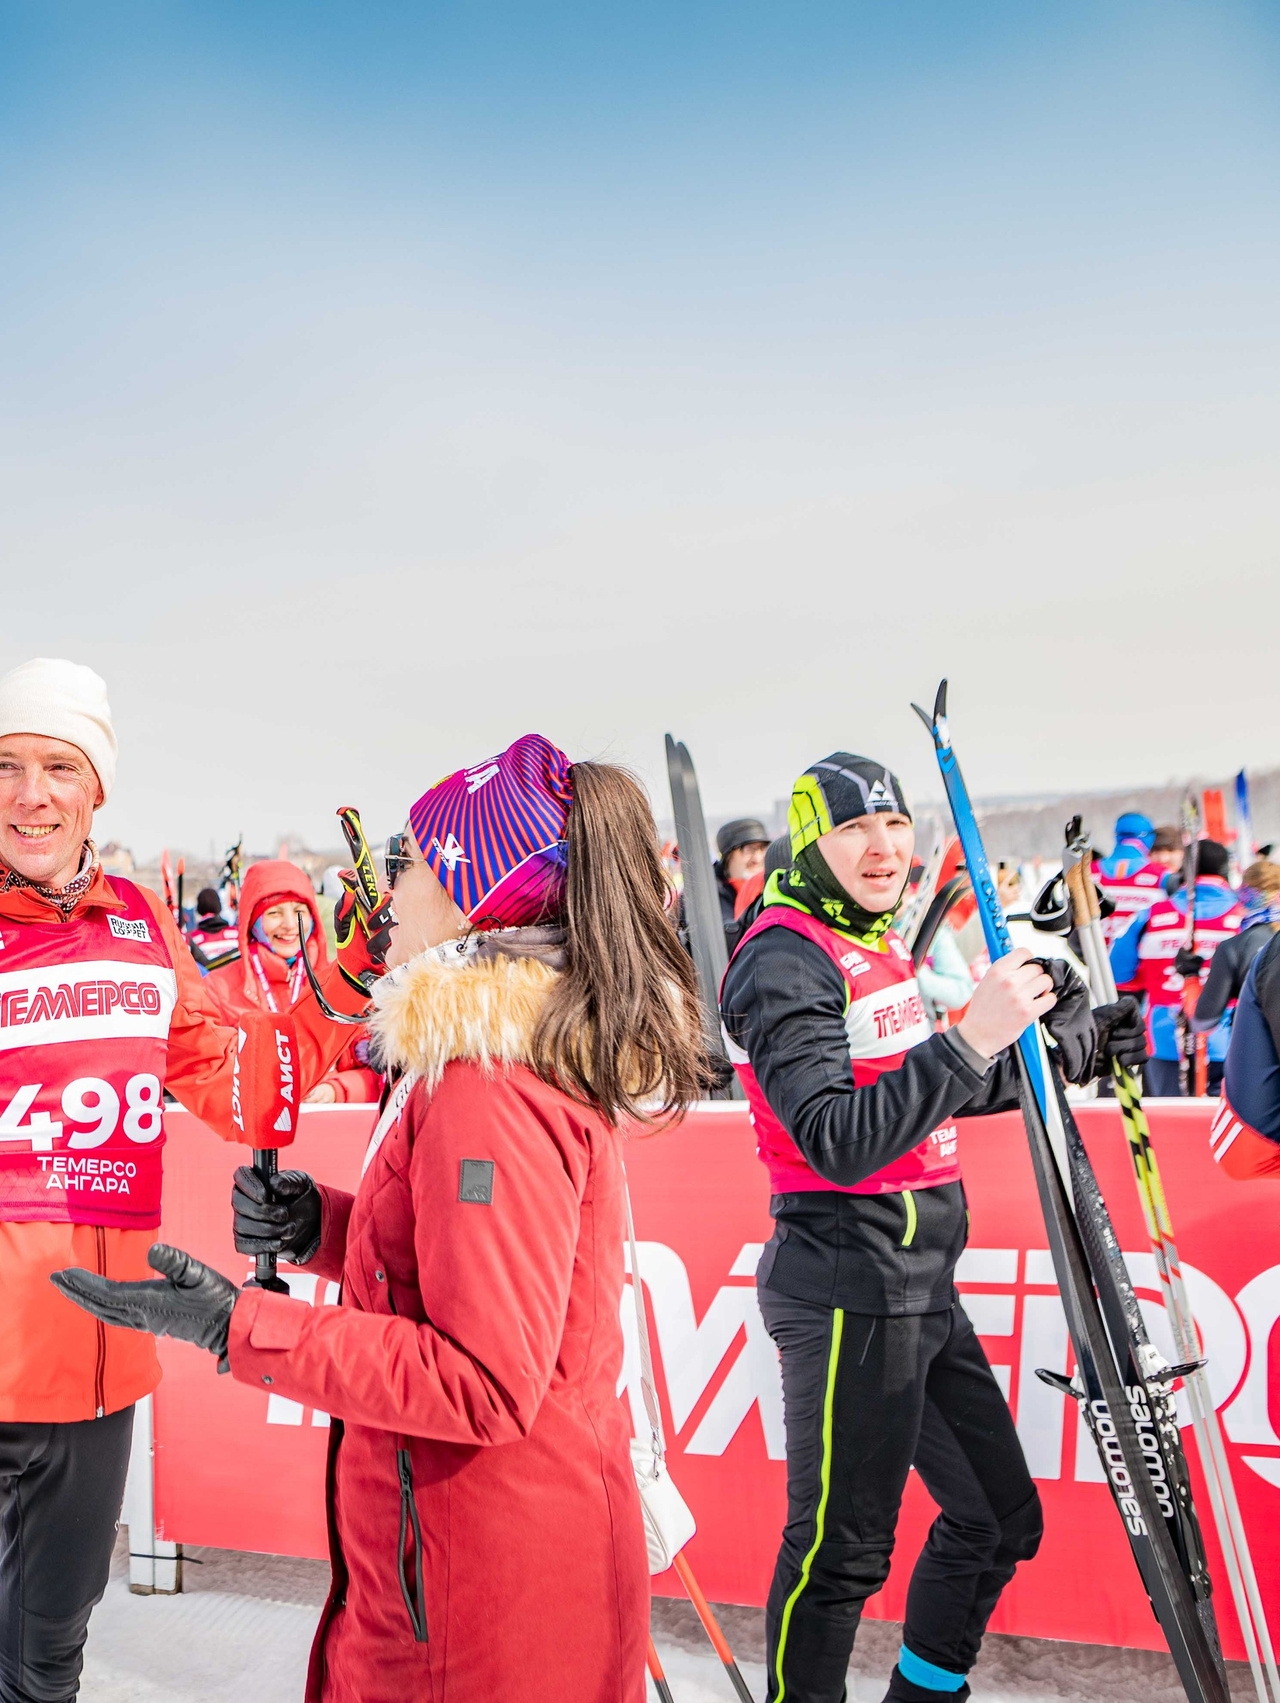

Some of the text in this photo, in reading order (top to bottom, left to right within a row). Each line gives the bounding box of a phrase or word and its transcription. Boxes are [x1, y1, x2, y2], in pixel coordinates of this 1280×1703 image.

[361, 864, 377, 897] LEKI
[275, 1029, 294, 1105] АИСТ
[36, 1156, 137, 1178] ТЕМЕРСО
[45, 1174, 130, 1195] АНГАРА
